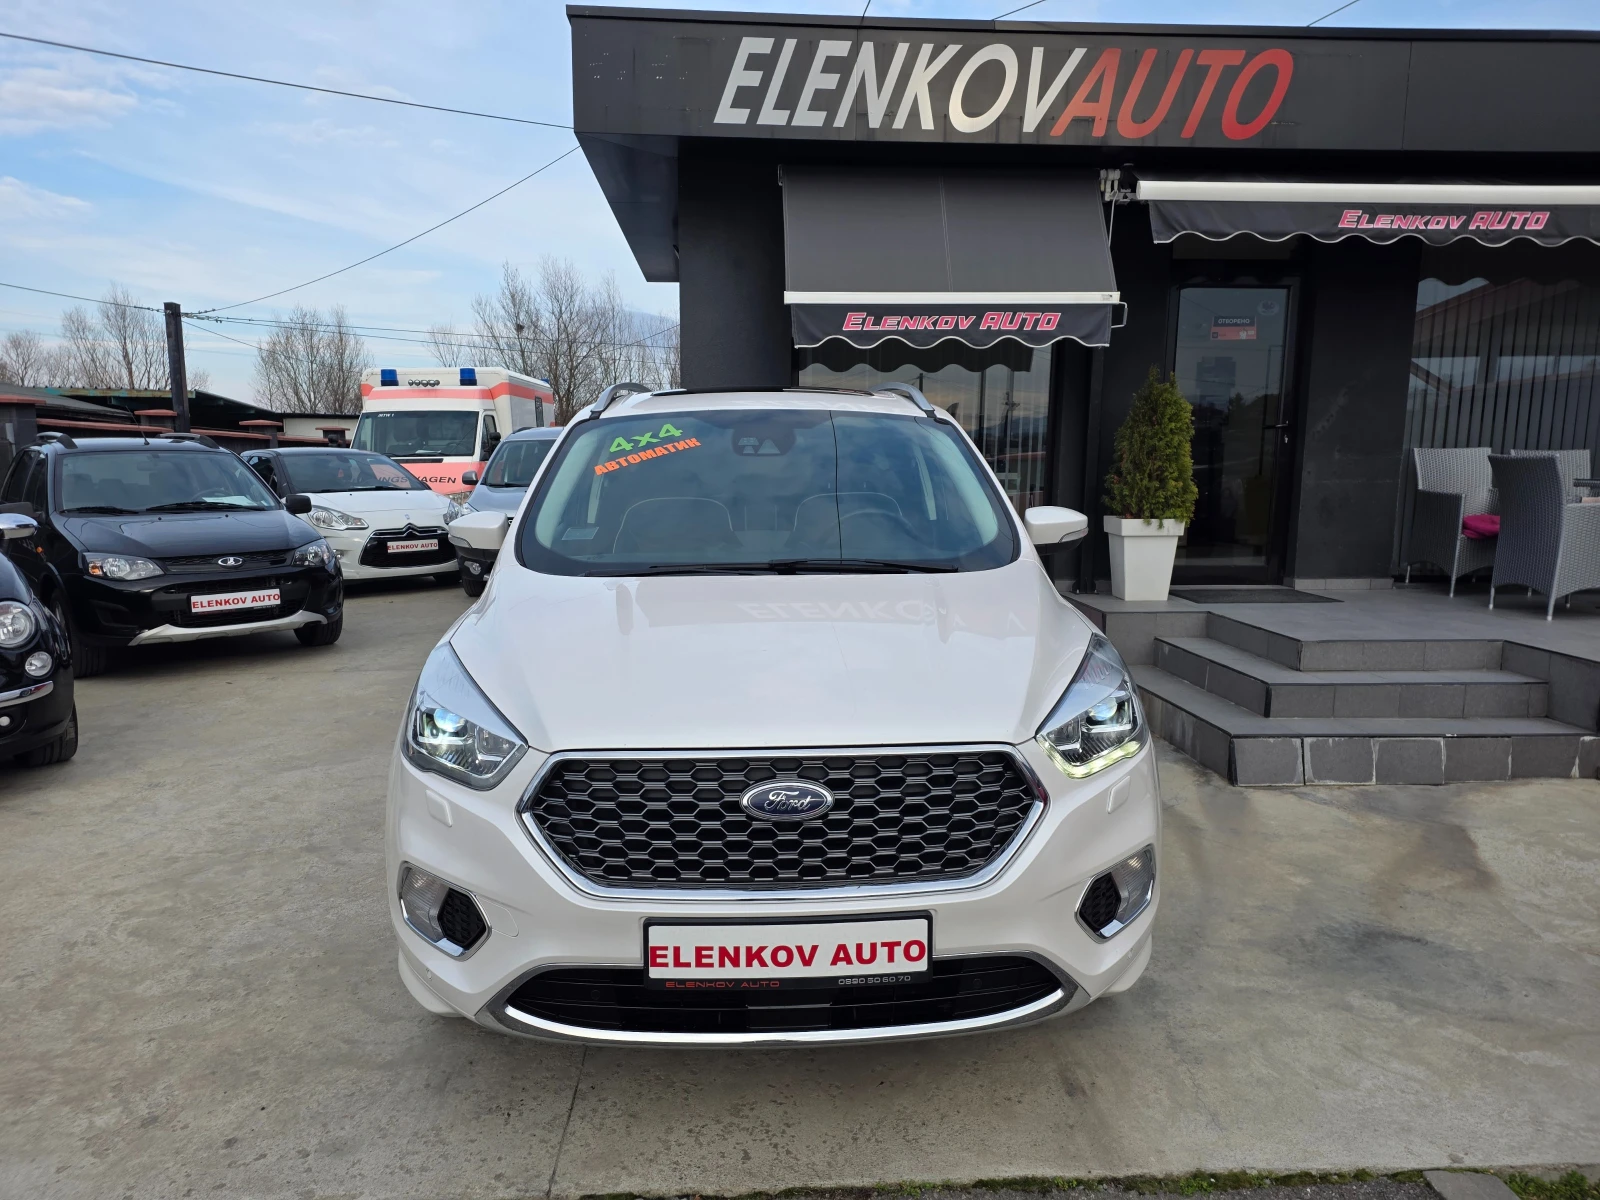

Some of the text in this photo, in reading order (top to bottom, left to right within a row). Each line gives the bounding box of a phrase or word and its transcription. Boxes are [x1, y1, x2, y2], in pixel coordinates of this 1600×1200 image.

[1468, 211, 1551, 230] AUTO
[979, 311, 1062, 331] AUTO
[594, 437, 702, 476] АВТОМАТИК
[387, 543, 419, 551] ELENKOV
[192, 597, 247, 609] ELENKOV
[251, 593, 280, 604] AUTO
[764, 790, 812, 811] Ford
[650, 939, 926, 968] ELENKOV AUTO
